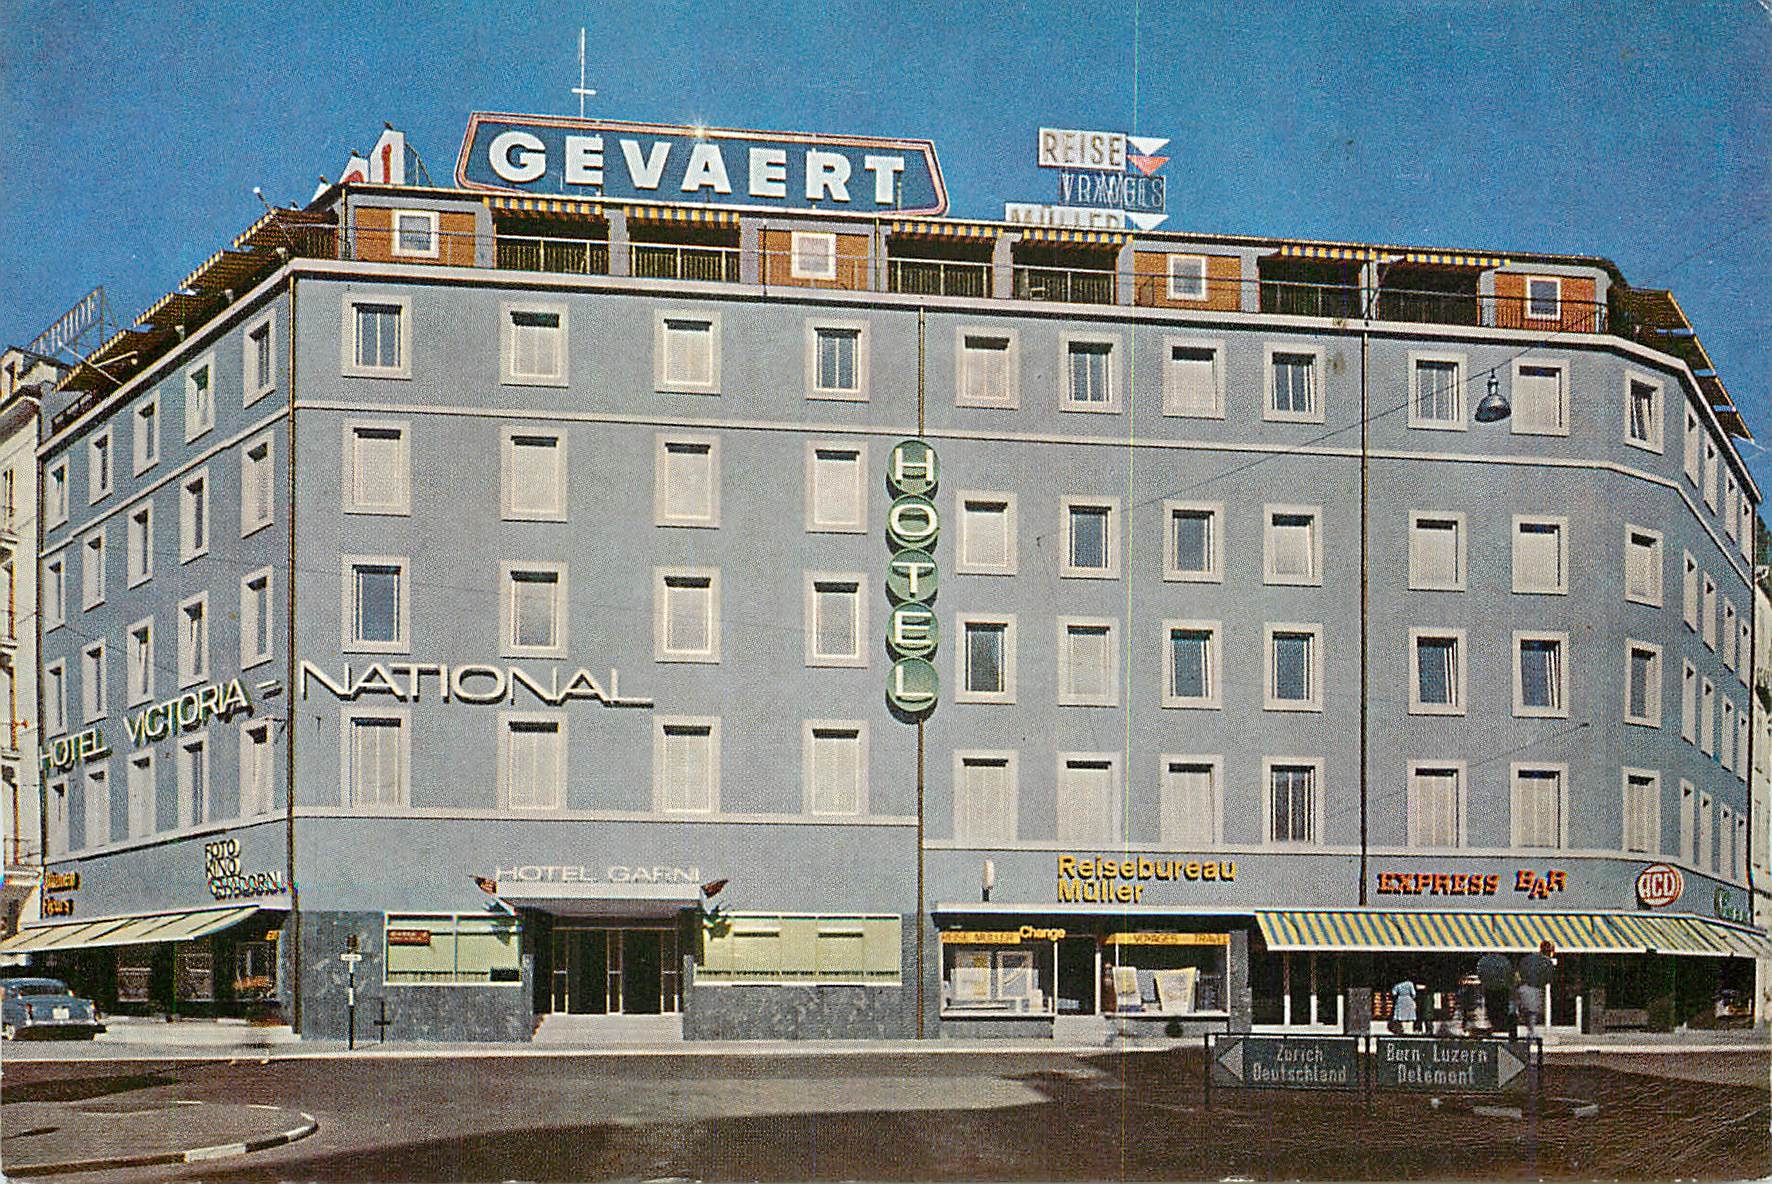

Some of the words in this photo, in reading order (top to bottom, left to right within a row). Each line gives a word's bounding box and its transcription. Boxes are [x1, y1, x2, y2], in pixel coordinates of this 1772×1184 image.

[1042, 133, 1122, 166] REISE
[488, 130, 905, 204] GEVAERT
[890, 447, 938, 698] HOTEL
[300, 659, 653, 705] NATIONAL
[40, 727, 109, 770] HOTEL
[123, 678, 250, 745] VICTORIA
[205, 839, 240, 859] FOTO
[496, 866, 594, 882] HOTEL
[607, 866, 701, 883] GARNI
[1057, 855, 1237, 881] Reisebureau
[1376, 873, 1499, 895] EXPRESS
[1514, 870, 1568, 899] BAR
[1020, 925, 1067, 941] Change
[1433, 1043, 1488, 1063] Luzern
[1253, 1062, 1347, 1081] Deutschland
